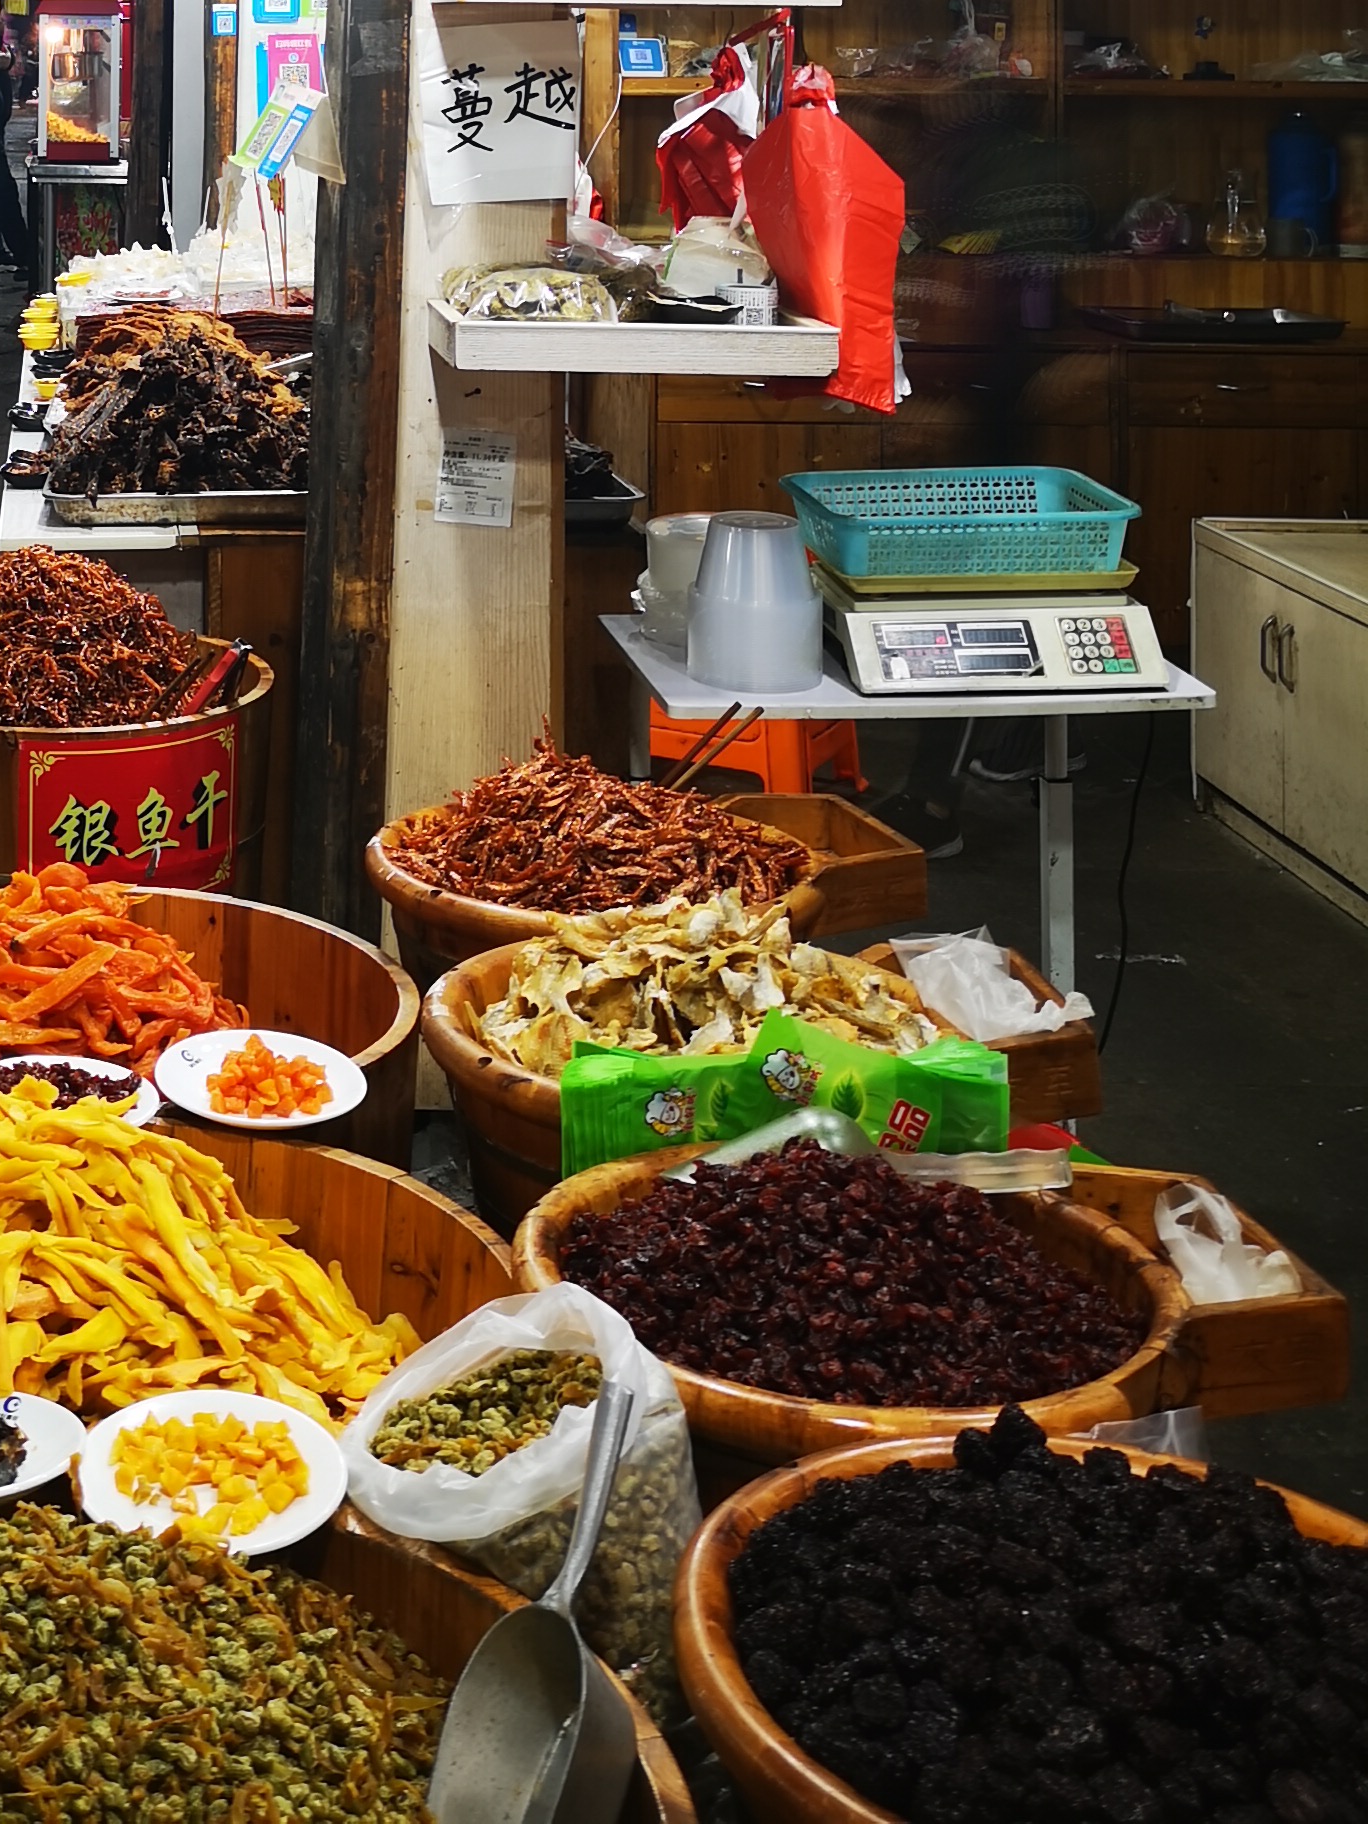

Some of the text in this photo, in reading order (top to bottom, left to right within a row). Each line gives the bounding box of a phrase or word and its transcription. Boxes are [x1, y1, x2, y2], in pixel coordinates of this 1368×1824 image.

[441, 62, 576, 153] 蔓越
[49, 770, 228, 867] 银鱼干
